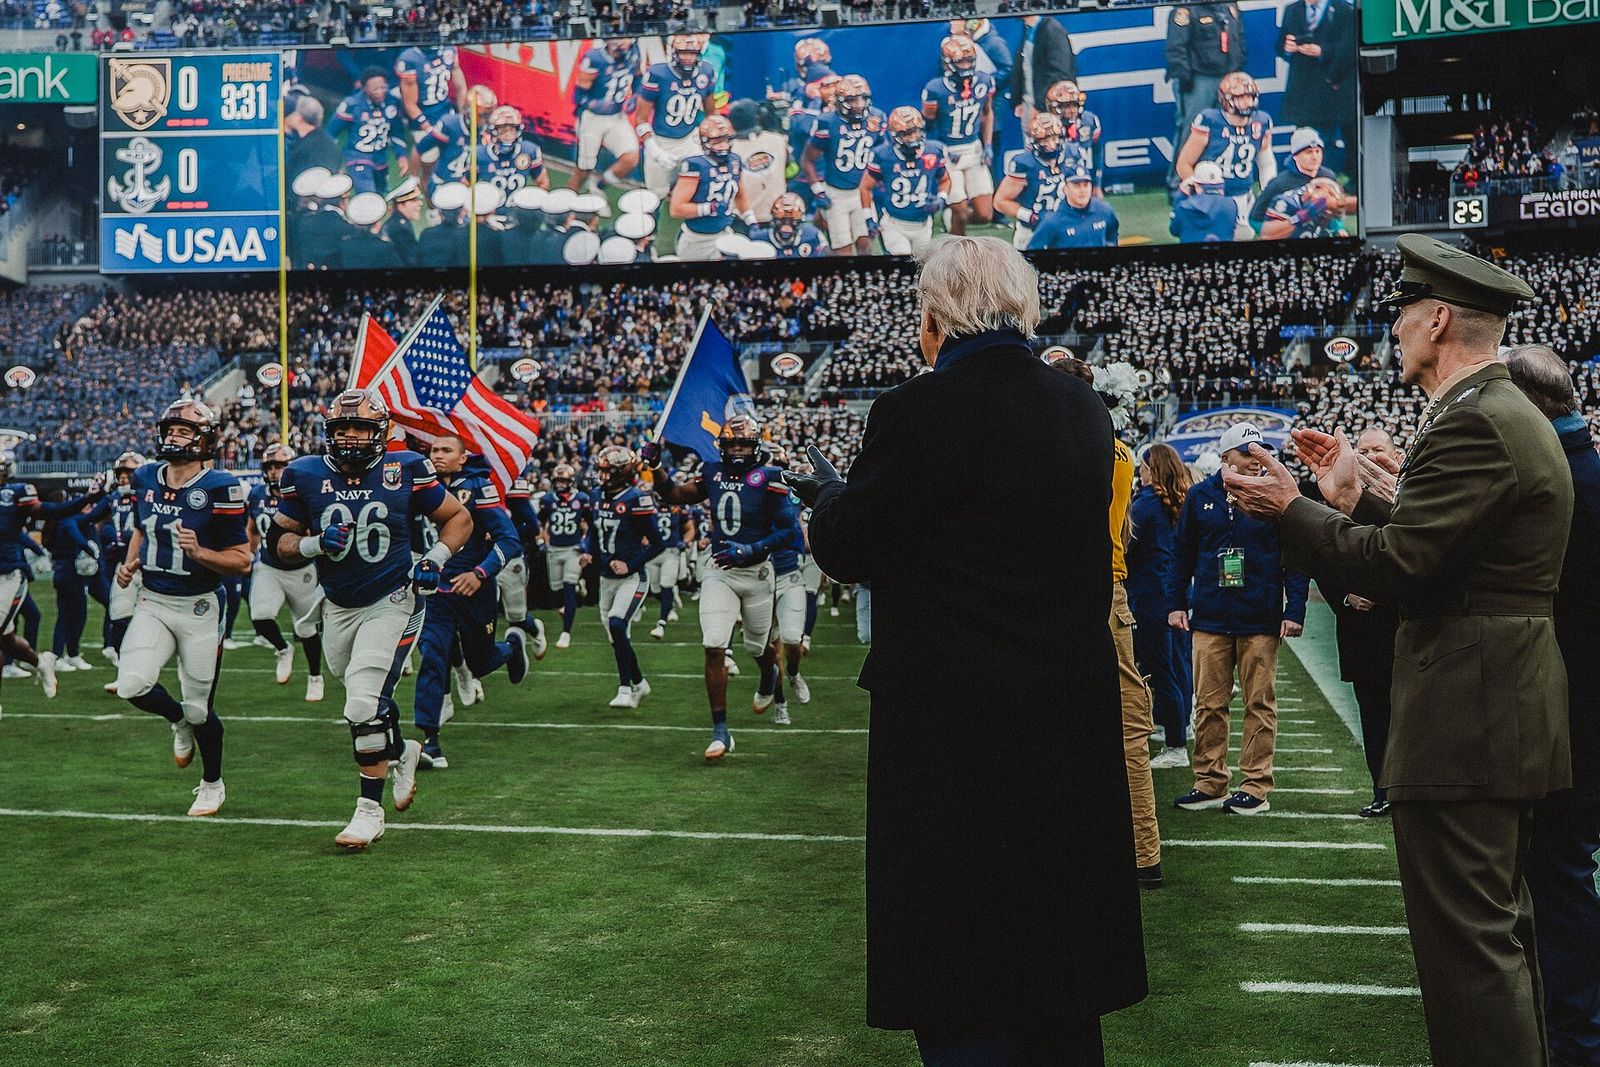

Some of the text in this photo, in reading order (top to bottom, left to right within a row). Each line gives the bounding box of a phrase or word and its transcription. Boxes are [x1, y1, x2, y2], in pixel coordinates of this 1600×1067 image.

[0, 55, 70, 99] ank
[178, 66, 198, 111] 0
[220, 82, 268, 120] 3:31
[664, 92, 703, 127] 90
[948, 102, 980, 139] 17
[834, 135, 874, 173] 56
[1214, 142, 1257, 179] 43
[1582, 145, 1600, 158] NA
[178, 148, 198, 193] 0
[890, 174, 928, 209] 34
[1543, 189, 1600, 201] AMERICA
[1454, 199, 1482, 224] 25
[166, 227, 267, 264] USAA
[334, 489, 374, 502] NAVY
[719, 481, 745, 492] NAVY
[151, 502, 184, 517] NAVY
[550, 510, 578, 536] 35
[716, 490, 742, 537] 0
[141, 513, 192, 576] 11
[592, 517, 621, 555] 17
